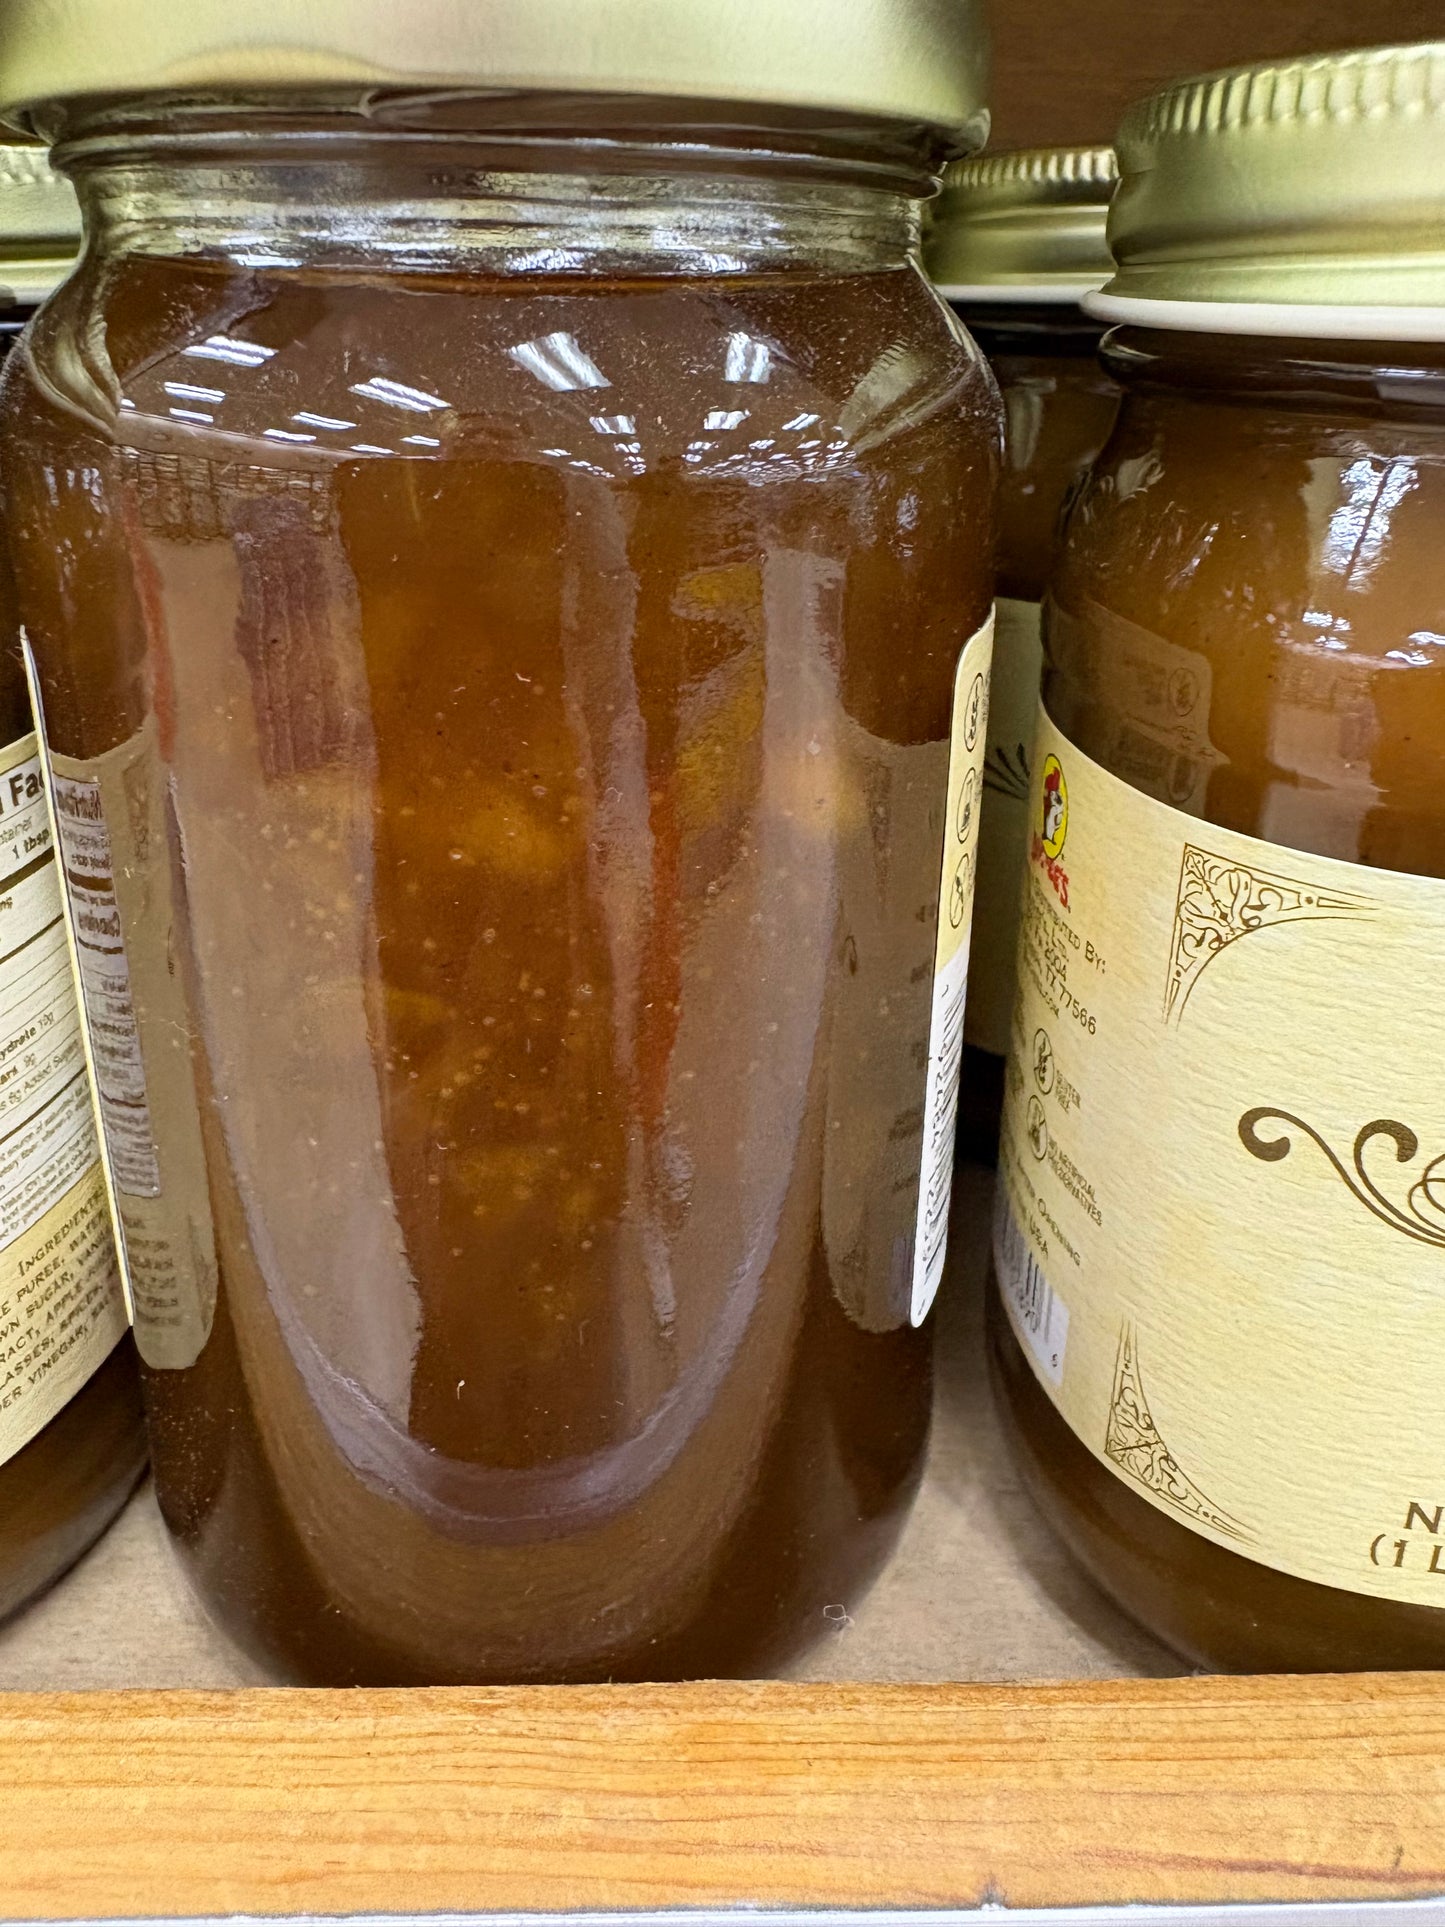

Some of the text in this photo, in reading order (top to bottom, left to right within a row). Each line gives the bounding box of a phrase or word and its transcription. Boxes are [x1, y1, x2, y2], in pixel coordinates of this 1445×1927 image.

[1058, 980, 1097, 1036] 77566
[0, 1026, 36, 1061] ydrate
[16, 1256, 65, 1303] PUREE,
[1370, 1533, 1409, 1567] (1
